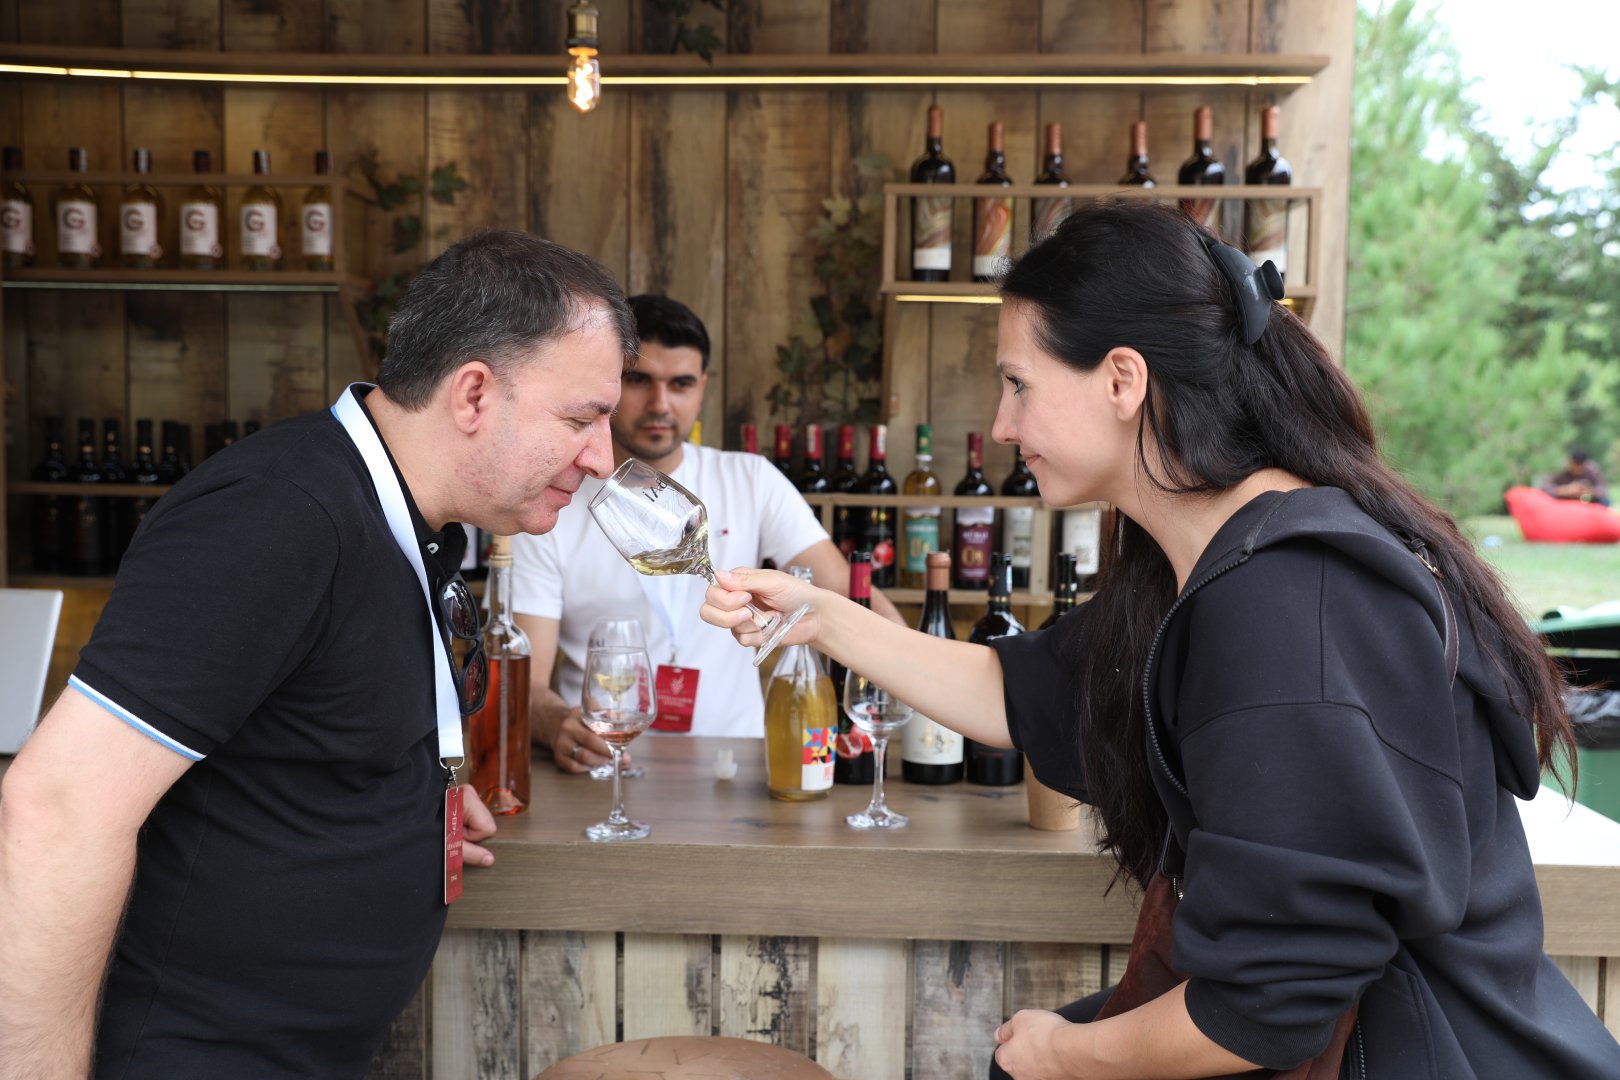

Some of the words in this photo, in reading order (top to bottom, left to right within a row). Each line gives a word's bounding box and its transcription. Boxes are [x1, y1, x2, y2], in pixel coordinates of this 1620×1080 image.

[62, 208, 86, 230] G
[124, 208, 144, 231] G
[185, 209, 206, 232] G
[244, 209, 266, 233] G
[305, 209, 326, 232] G
